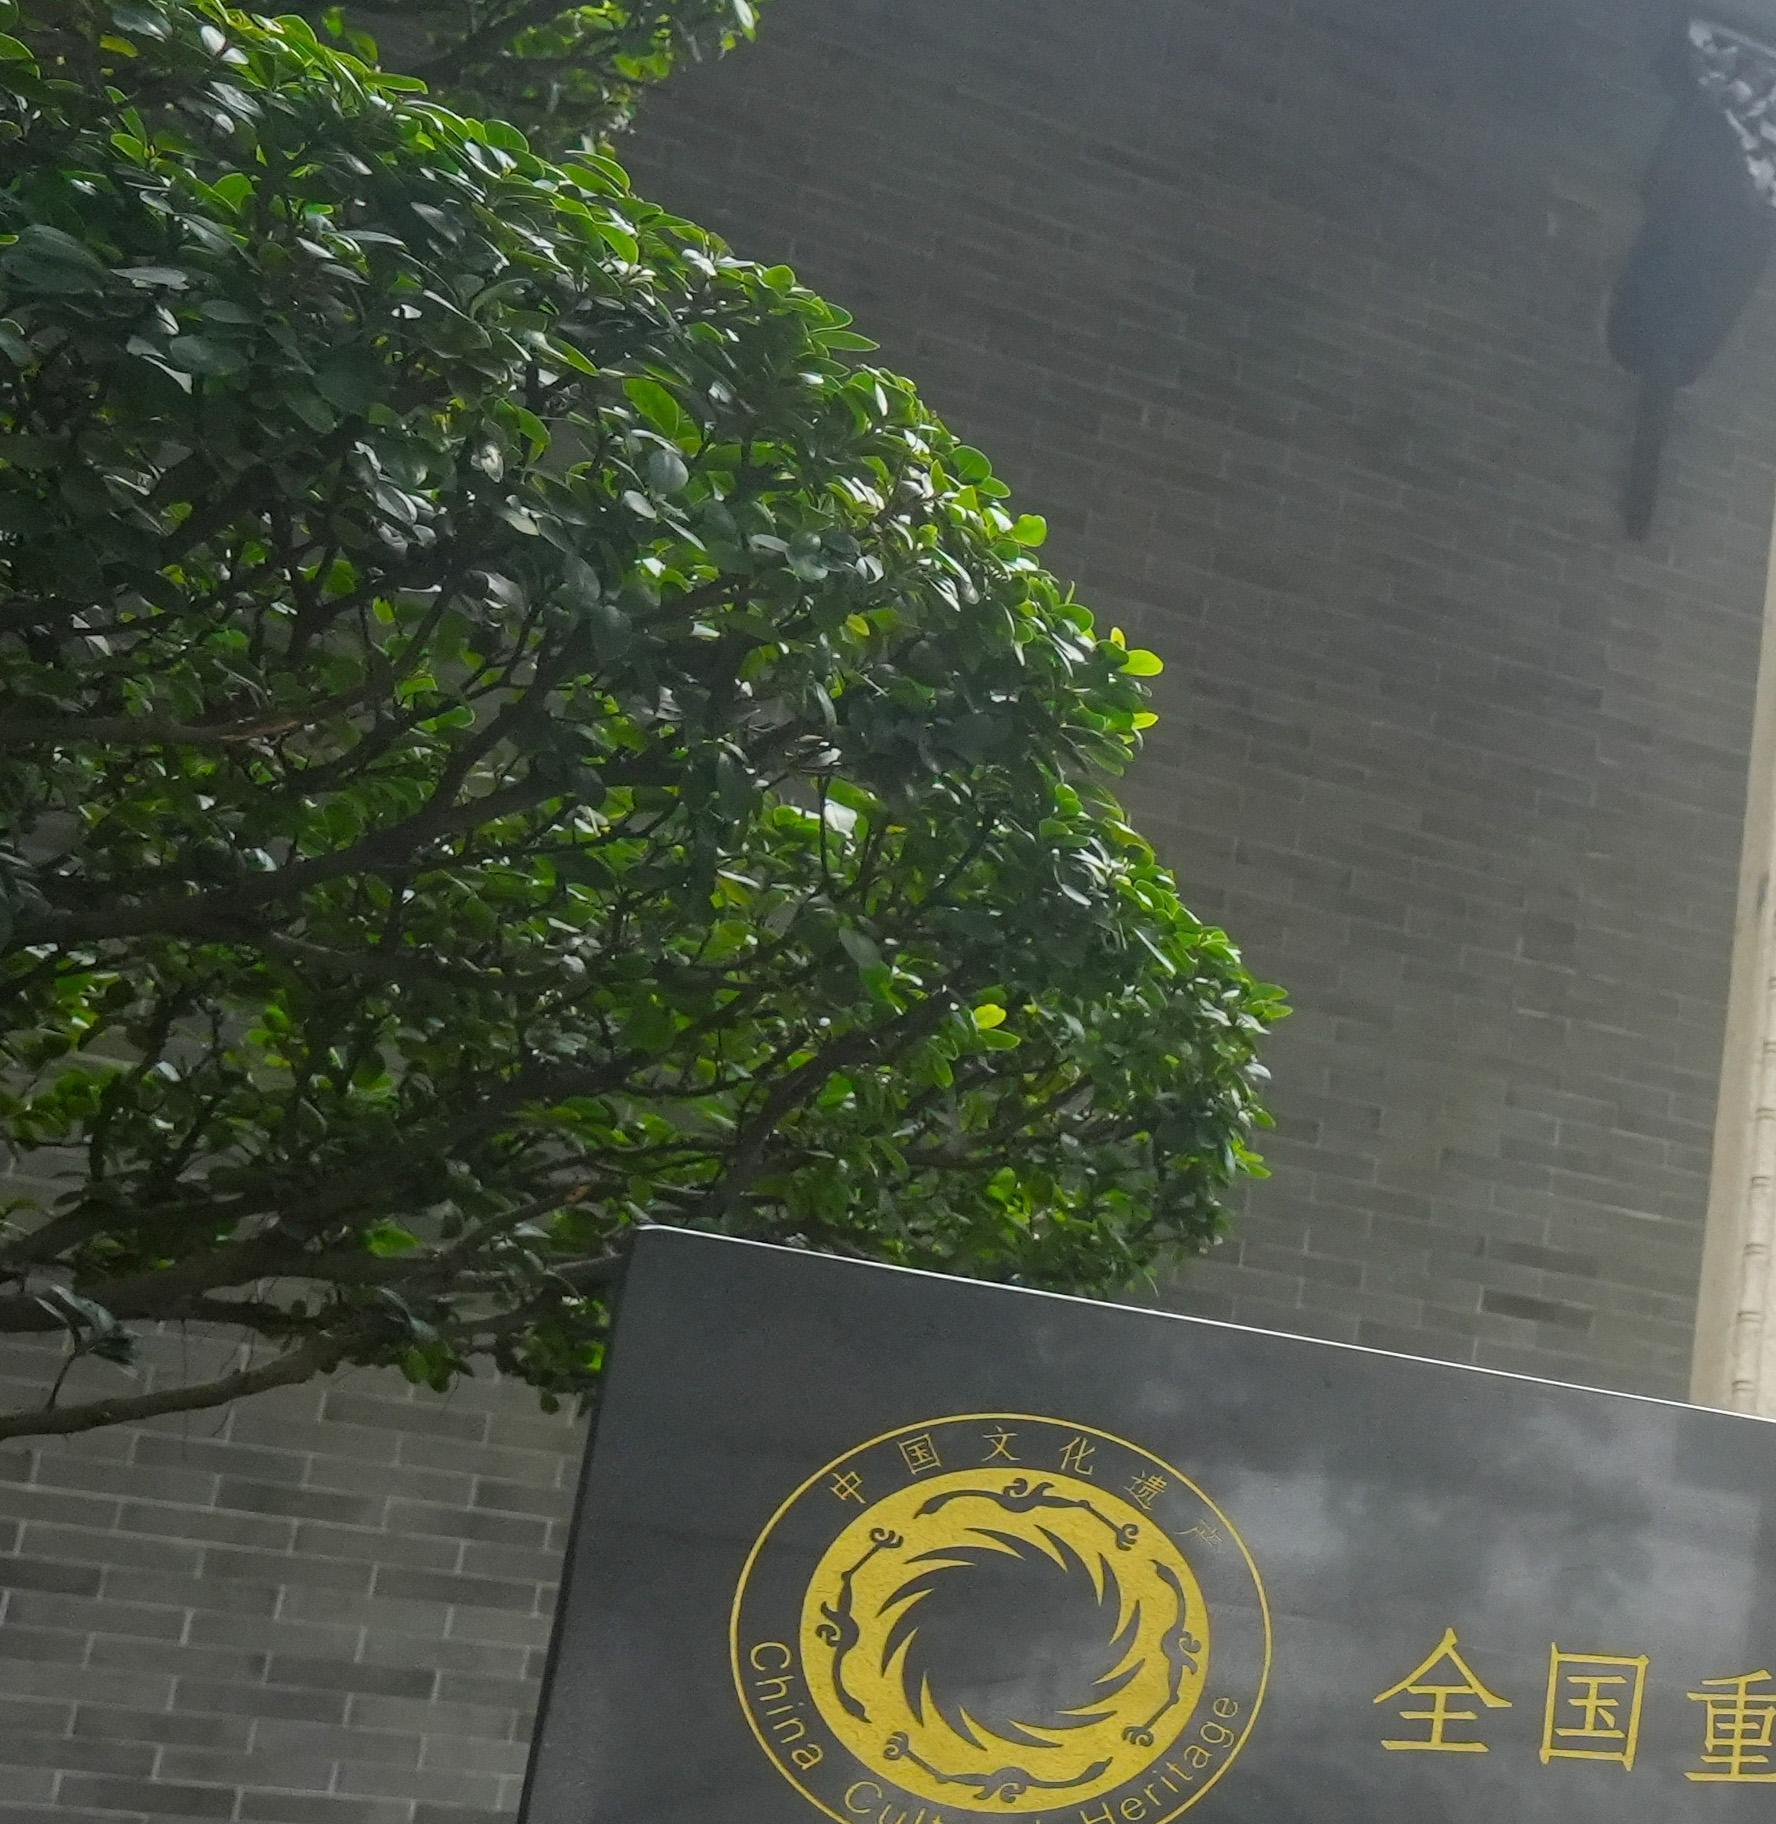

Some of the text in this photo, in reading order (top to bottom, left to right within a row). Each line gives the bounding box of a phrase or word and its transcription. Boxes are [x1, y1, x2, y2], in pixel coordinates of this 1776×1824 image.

[829, 1426, 1224, 1552] 中国文化遗产
[750, 1641, 824, 1771] China
